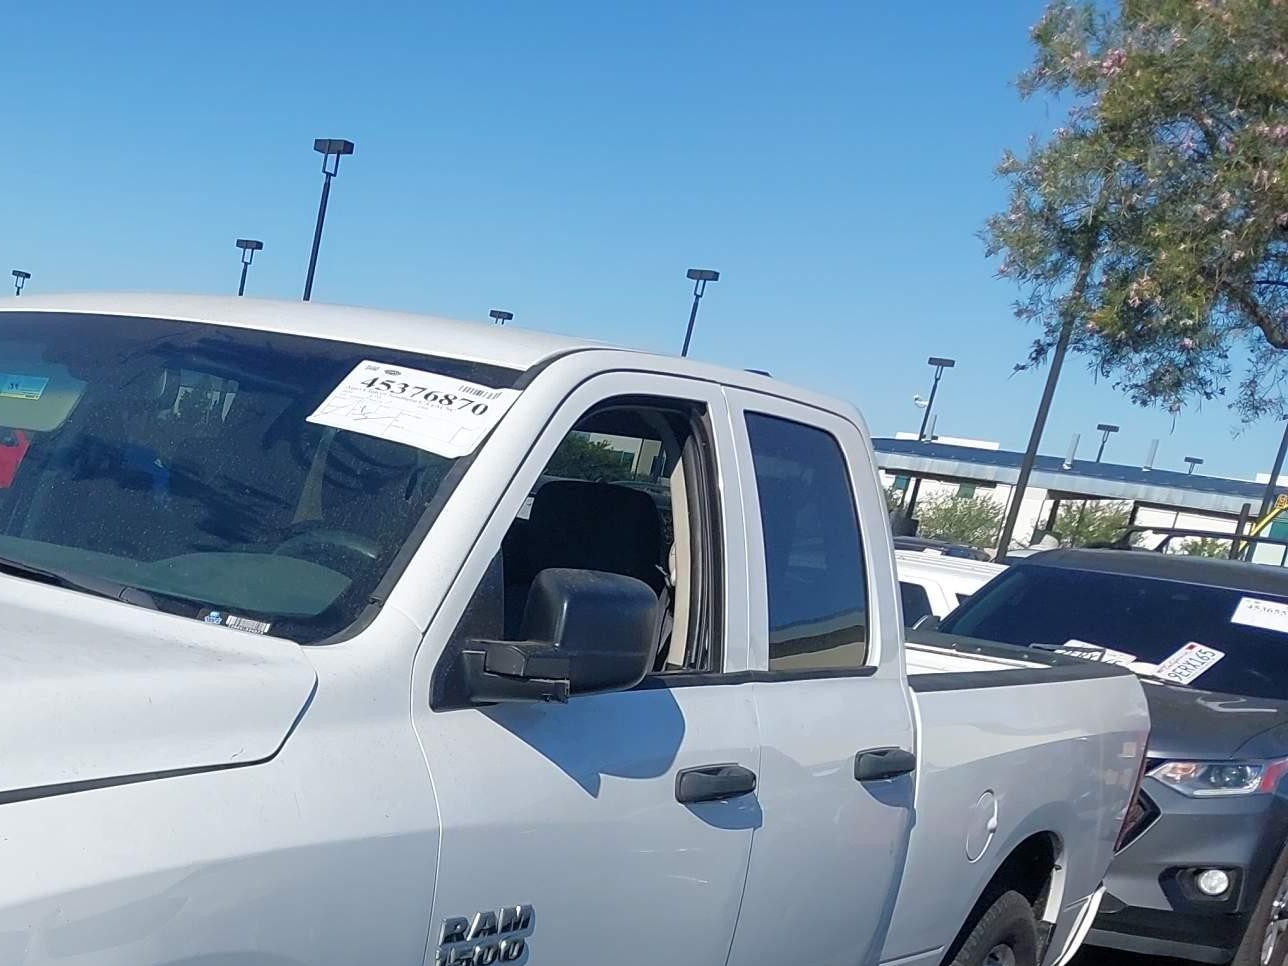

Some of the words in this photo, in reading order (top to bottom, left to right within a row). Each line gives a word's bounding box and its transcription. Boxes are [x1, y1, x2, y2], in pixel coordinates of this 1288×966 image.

[361, 377, 489, 416] 45376870
[1168, 648, 1216, 681] 9ERX165
[438, 904, 533, 946] RAM
